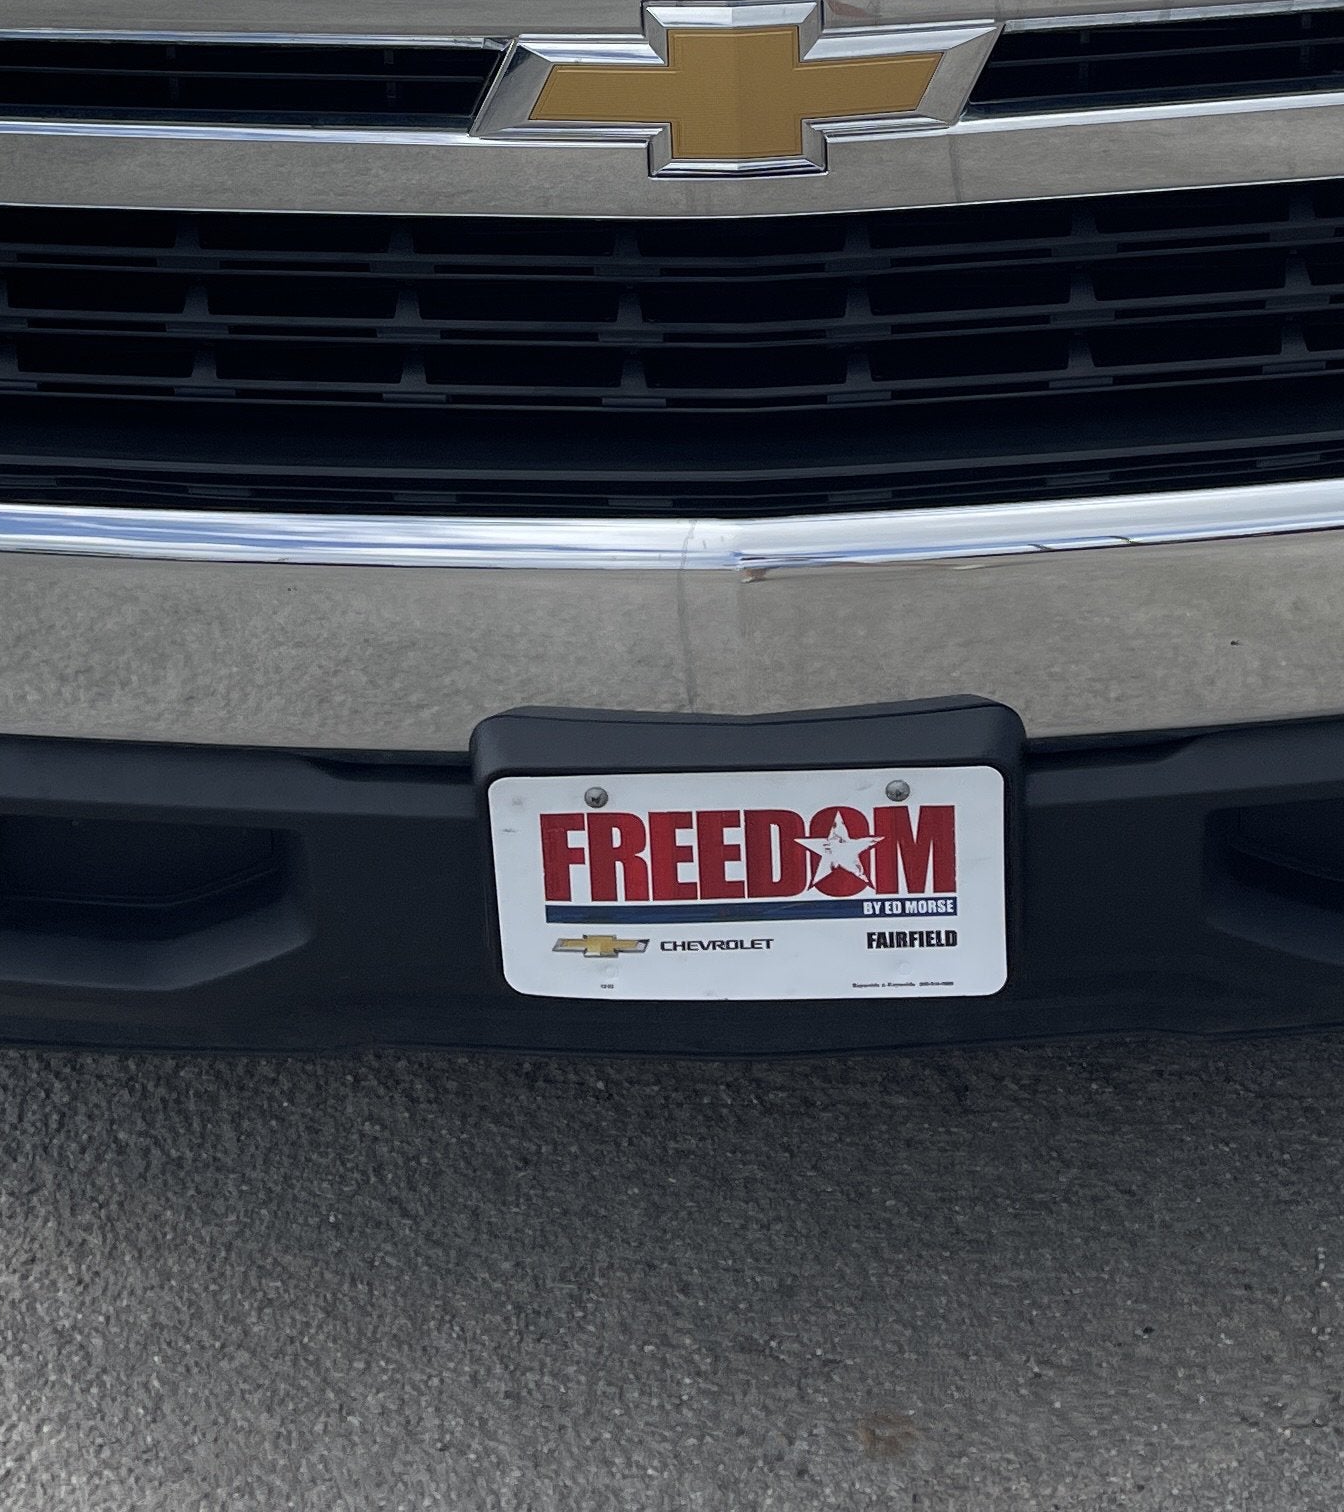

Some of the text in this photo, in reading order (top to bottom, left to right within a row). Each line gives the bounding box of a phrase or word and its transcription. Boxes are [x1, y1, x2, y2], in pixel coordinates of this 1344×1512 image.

[540, 805, 956, 902] FREEDOM
[863, 899, 954, 915] BY ED MORSE
[660, 938, 774, 952] CHEVROLET
[866, 930, 958, 949] FAIRFIELD
